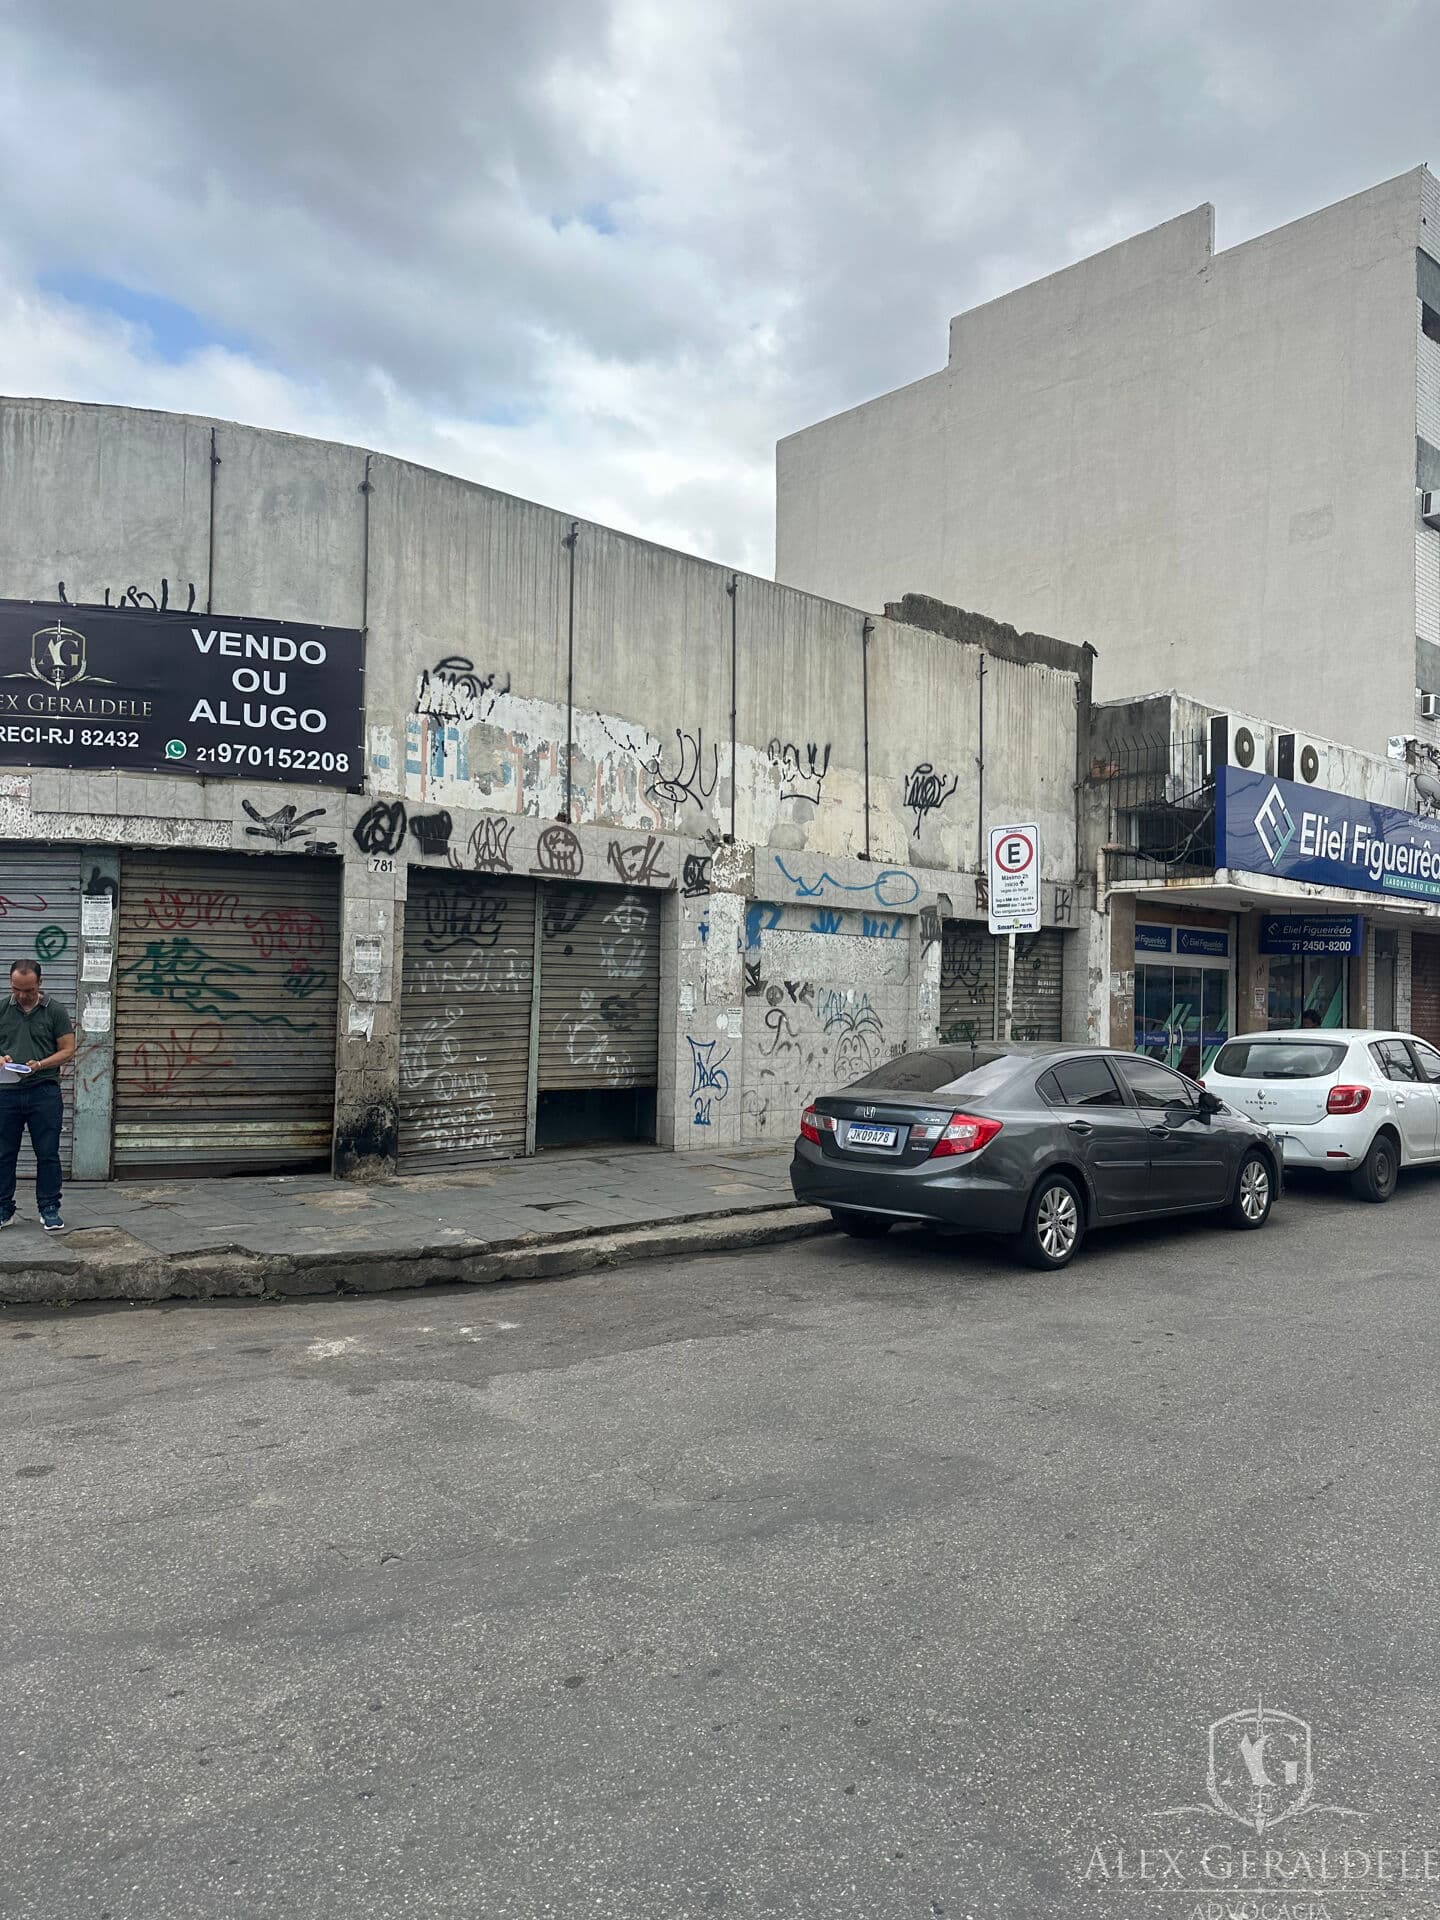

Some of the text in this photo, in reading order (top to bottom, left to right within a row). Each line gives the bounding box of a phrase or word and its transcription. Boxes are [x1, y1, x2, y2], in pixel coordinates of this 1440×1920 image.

[191, 628, 327, 665] VENDO
[232, 668, 287, 696] OU
[27, 693, 152, 717] GERALDELE
[188, 699, 327, 733] ALUGO
[80, 730, 140, 748] 82432
[1300, 811, 1347, 862] Eliel
[373, 859, 392, 872] 781
[1007, 843, 1021, 864] E
[1303, 941, 1352, 951] 2450-8200
